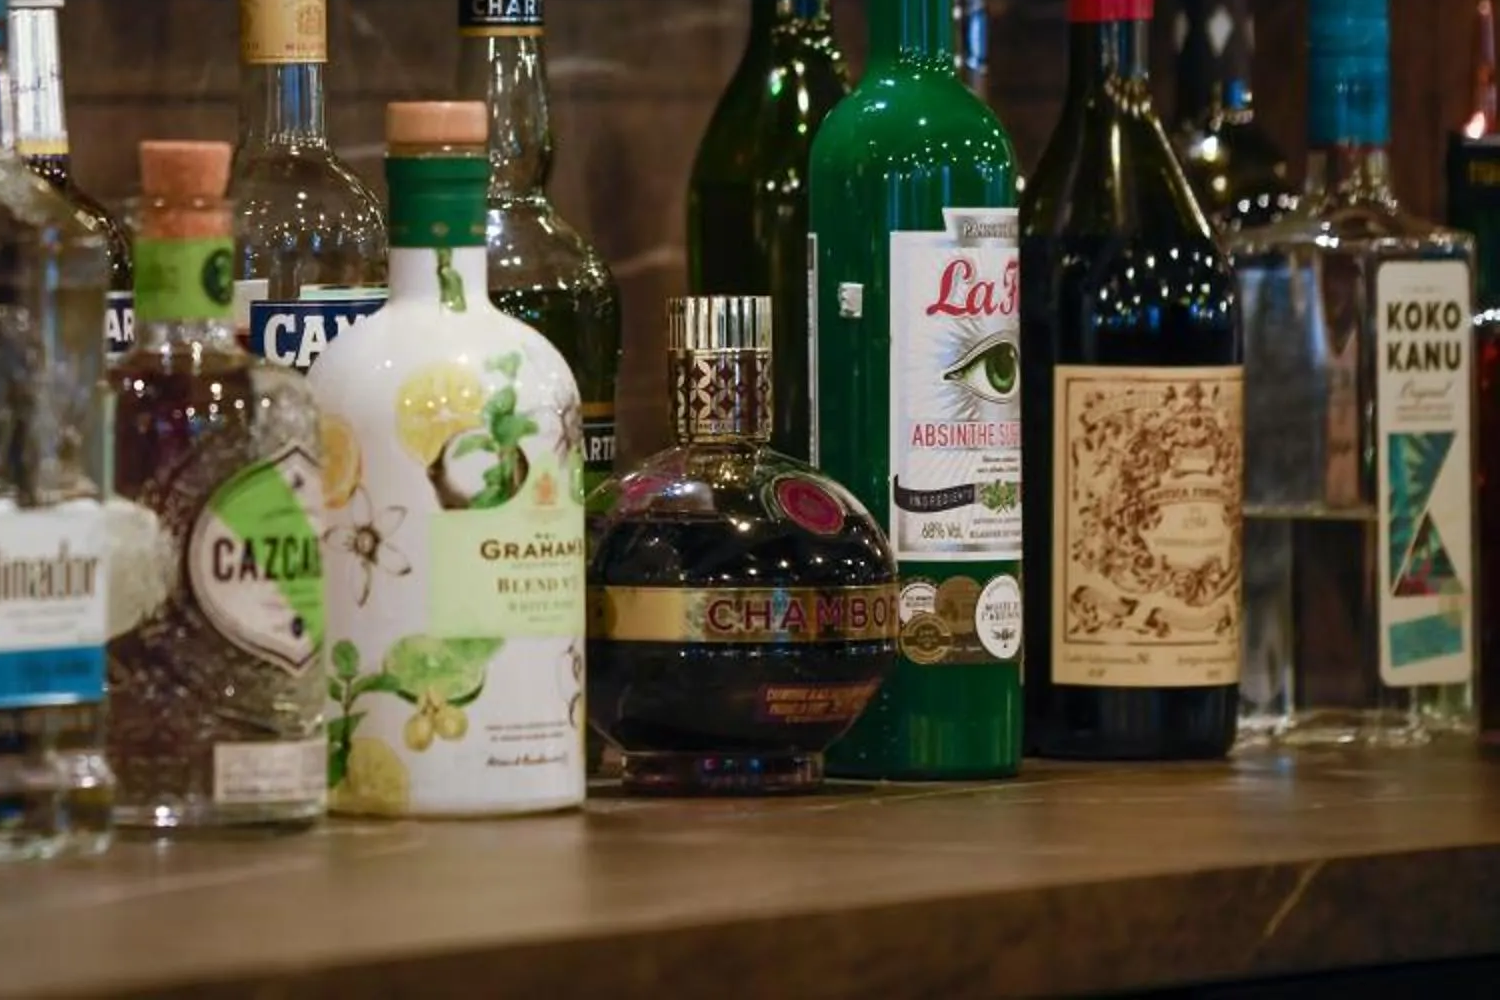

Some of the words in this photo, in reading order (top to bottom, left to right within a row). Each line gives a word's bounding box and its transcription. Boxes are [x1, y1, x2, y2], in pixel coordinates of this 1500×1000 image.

[1387, 302, 1461, 332] KOKO
[1387, 342, 1461, 372] KANU
[911, 423, 995, 447] ABSINTHE
